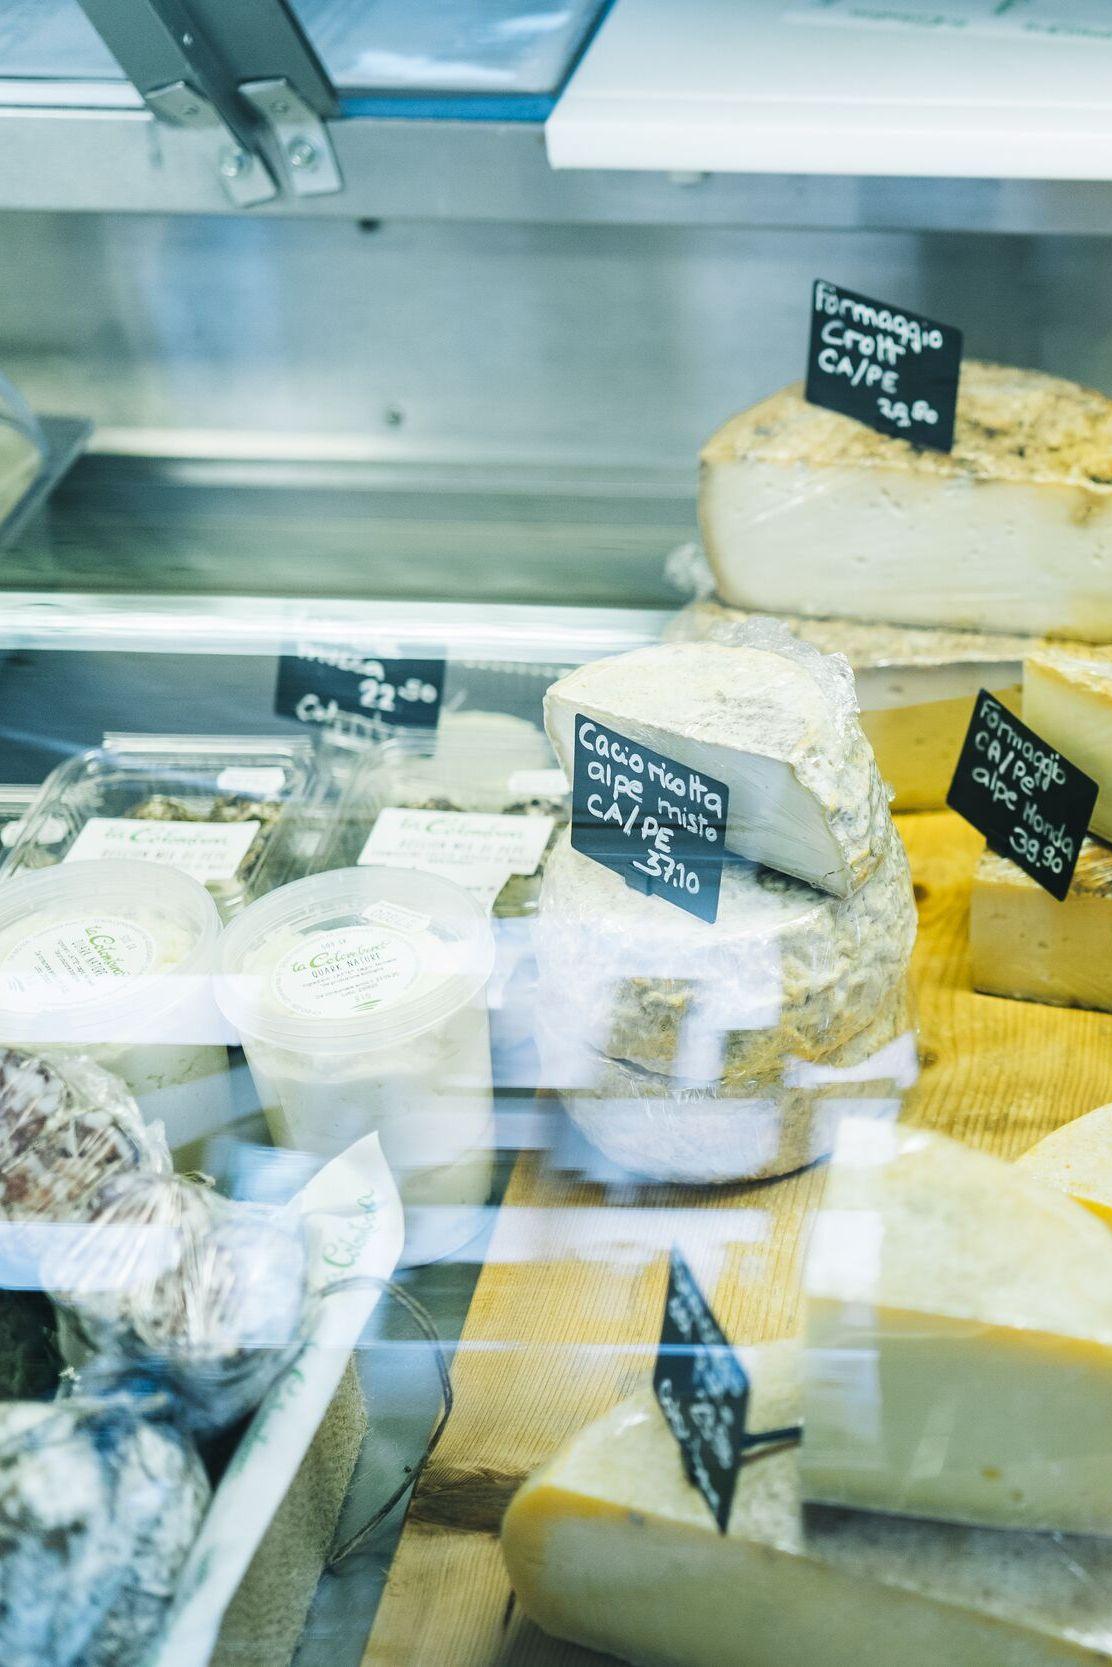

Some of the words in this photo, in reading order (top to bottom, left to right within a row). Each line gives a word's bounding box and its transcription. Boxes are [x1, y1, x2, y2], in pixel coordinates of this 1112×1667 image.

[814, 281, 944, 354] Formaggio
[818, 347, 900, 394] CA/PE
[980, 700, 1066, 792] Formaggio
[587, 761, 643, 804] alpe
[658, 797, 718, 842] misto
[971, 767, 1018, 811] alpe
[632, 848, 700, 894] 37.10
[1009, 826, 1063, 874] 39.90
